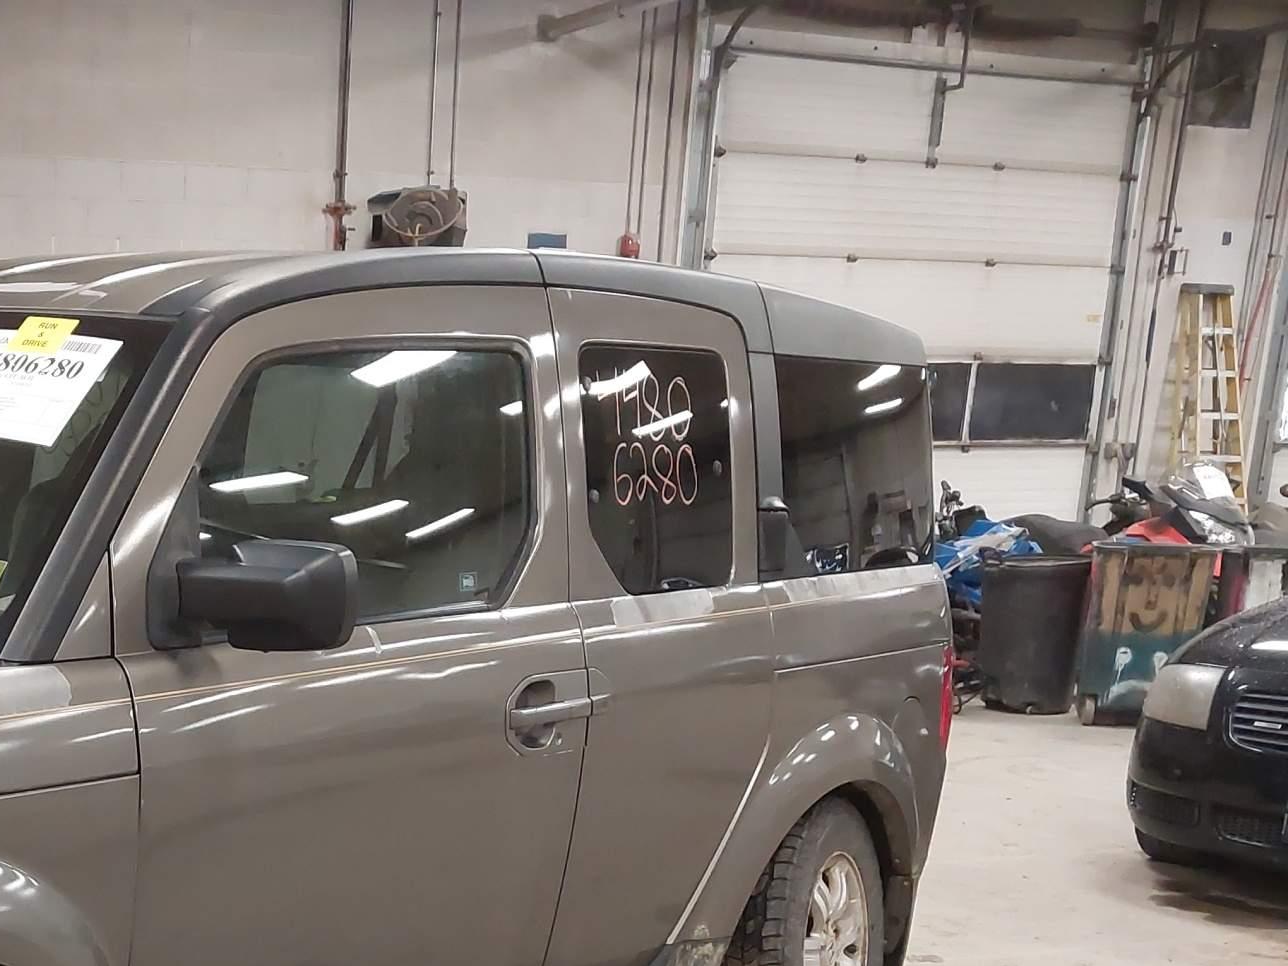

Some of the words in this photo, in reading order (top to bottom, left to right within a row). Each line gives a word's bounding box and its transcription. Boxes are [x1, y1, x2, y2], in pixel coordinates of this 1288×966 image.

[37, 322, 58, 330] RUN
[21, 339, 49, 348] DRIVE
[614, 442, 698, 505] 6280
